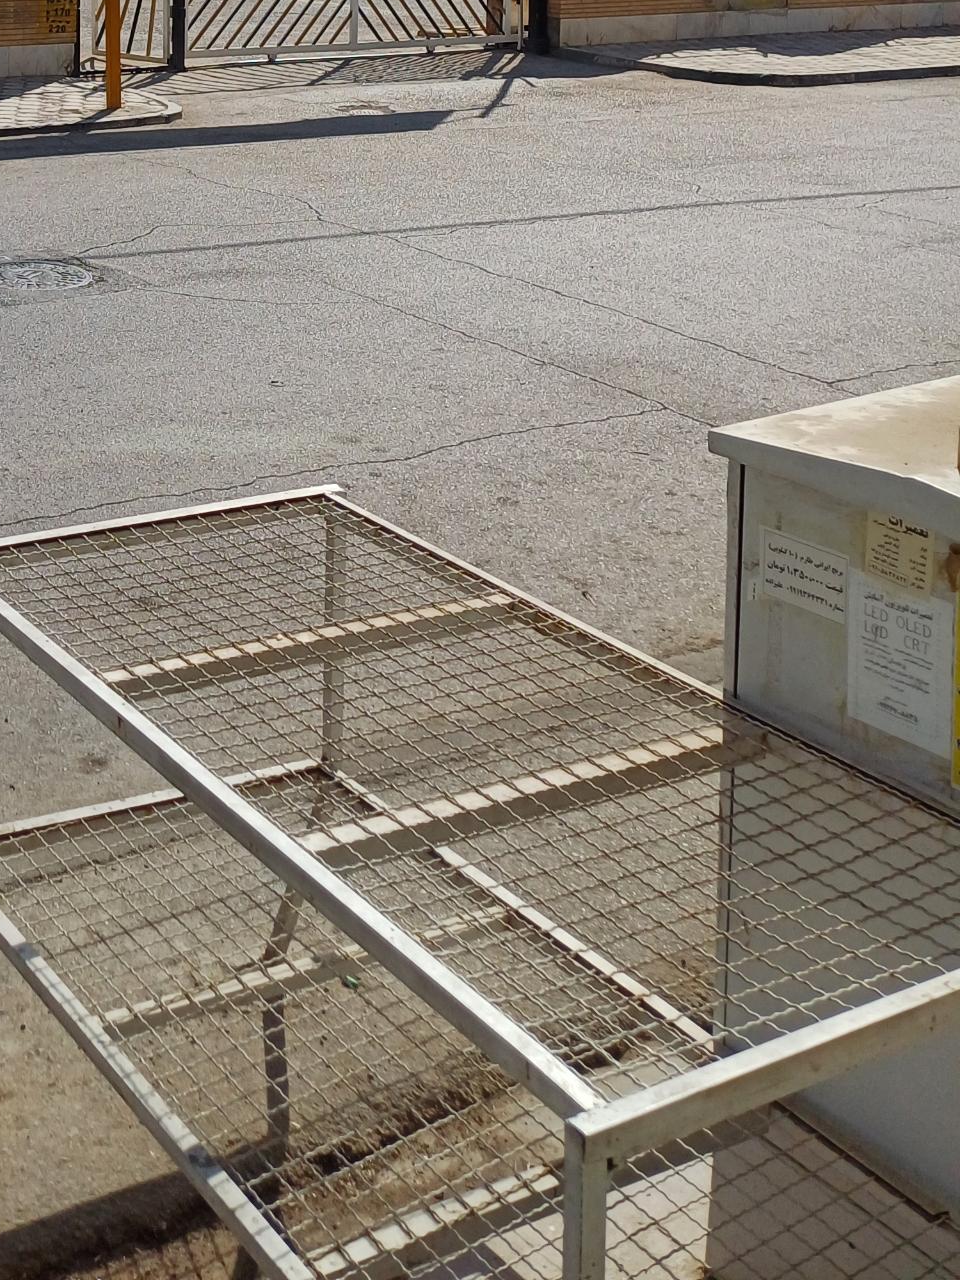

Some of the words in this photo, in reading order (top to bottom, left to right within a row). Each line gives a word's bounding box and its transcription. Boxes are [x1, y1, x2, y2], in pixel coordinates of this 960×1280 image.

[767, 560, 786, 574] تومان
[824, 582, 844, 595] قیمت
[864, 602, 888, 622] LED
[895, 615, 932, 638] OLED
[903, 635, 930, 655] CRT
